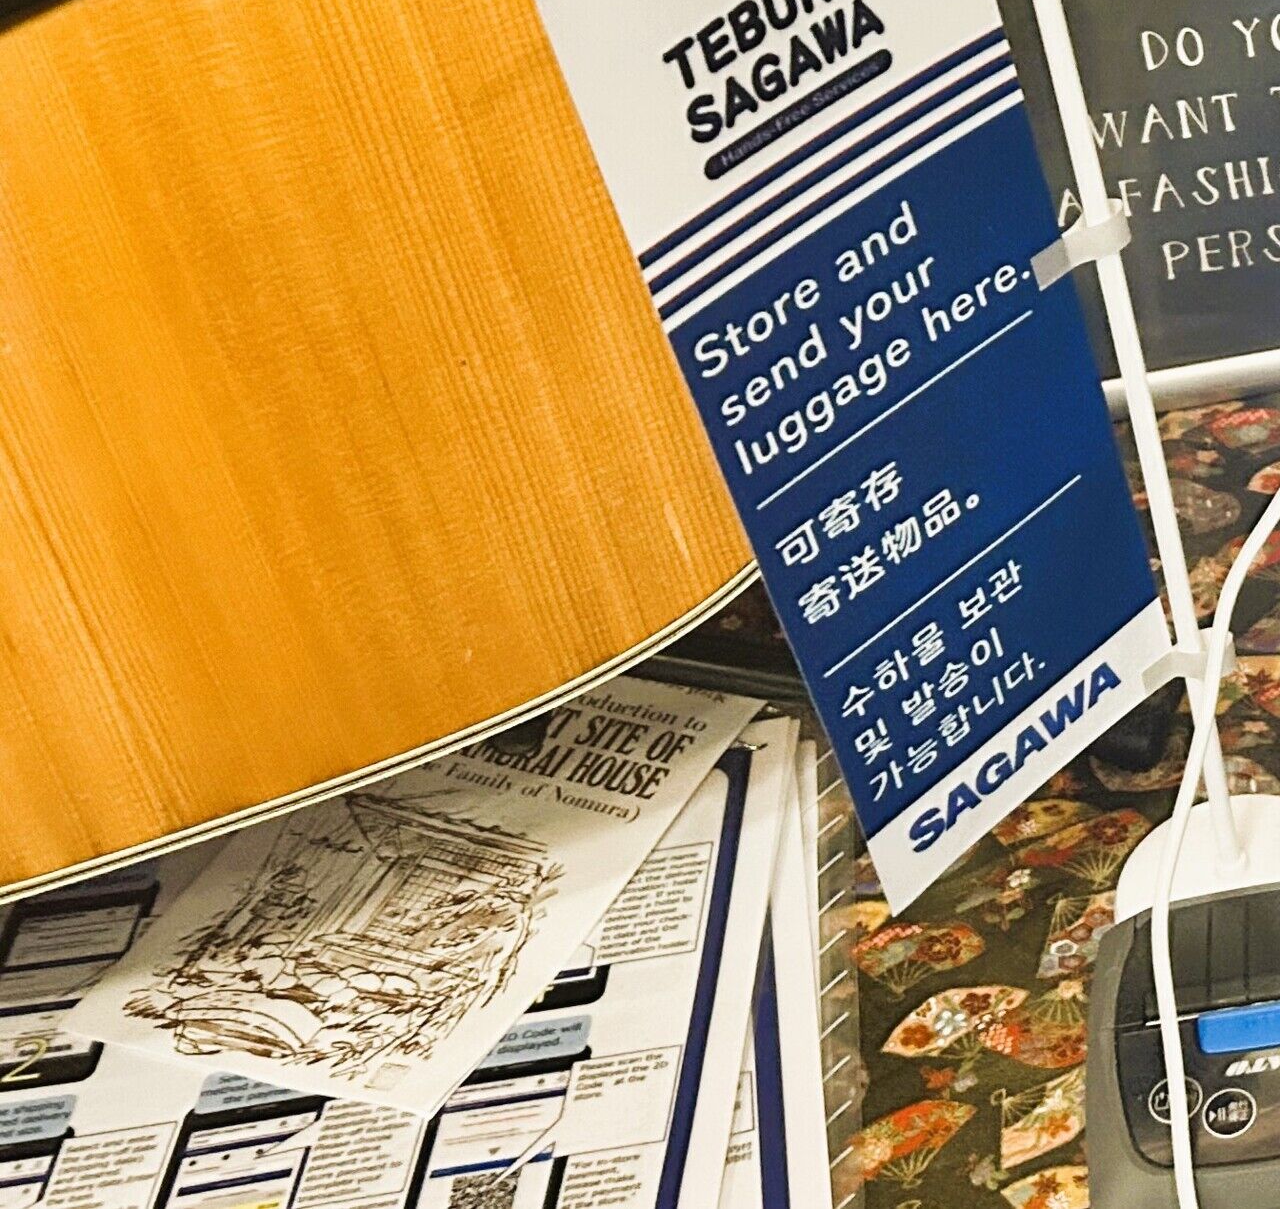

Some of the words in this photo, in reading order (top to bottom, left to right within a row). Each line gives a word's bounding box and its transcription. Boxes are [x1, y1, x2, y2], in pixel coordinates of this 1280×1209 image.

[1140, 26, 1205, 72] DO
[1087, 92, 1238, 150] WANT
[693, 277, 822, 379] Store
[834, 200, 919, 283] and
[720, 323, 829, 427] send
[839, 256, 935, 351] your
[734, 337, 912, 476] luggage
[921, 262, 1032, 343] here.
[775, 461, 904, 568] 可寄存
[798, 488, 982, 626] 寄送物品。
[841, 621, 948, 719] 수하물
[958, 560, 1024, 631] 보관
[855, 720, 894, 765] 및
[902, 627, 1006, 725] 발송이
[574, 714, 647, 754] SITE
[646, 729, 695, 765] OF
[577, 693, 680, 726] oduction
[683, 712, 708, 732] to
[869, 652, 1047, 803] 가능합니다.
[908, 661, 1122, 854] SAGAWA
[444, 762, 514, 794] Family
[521, 779, 548, 799] of
[568, 752, 670, 800] HOUSE
[1, 1038, 48, 1083] 2
